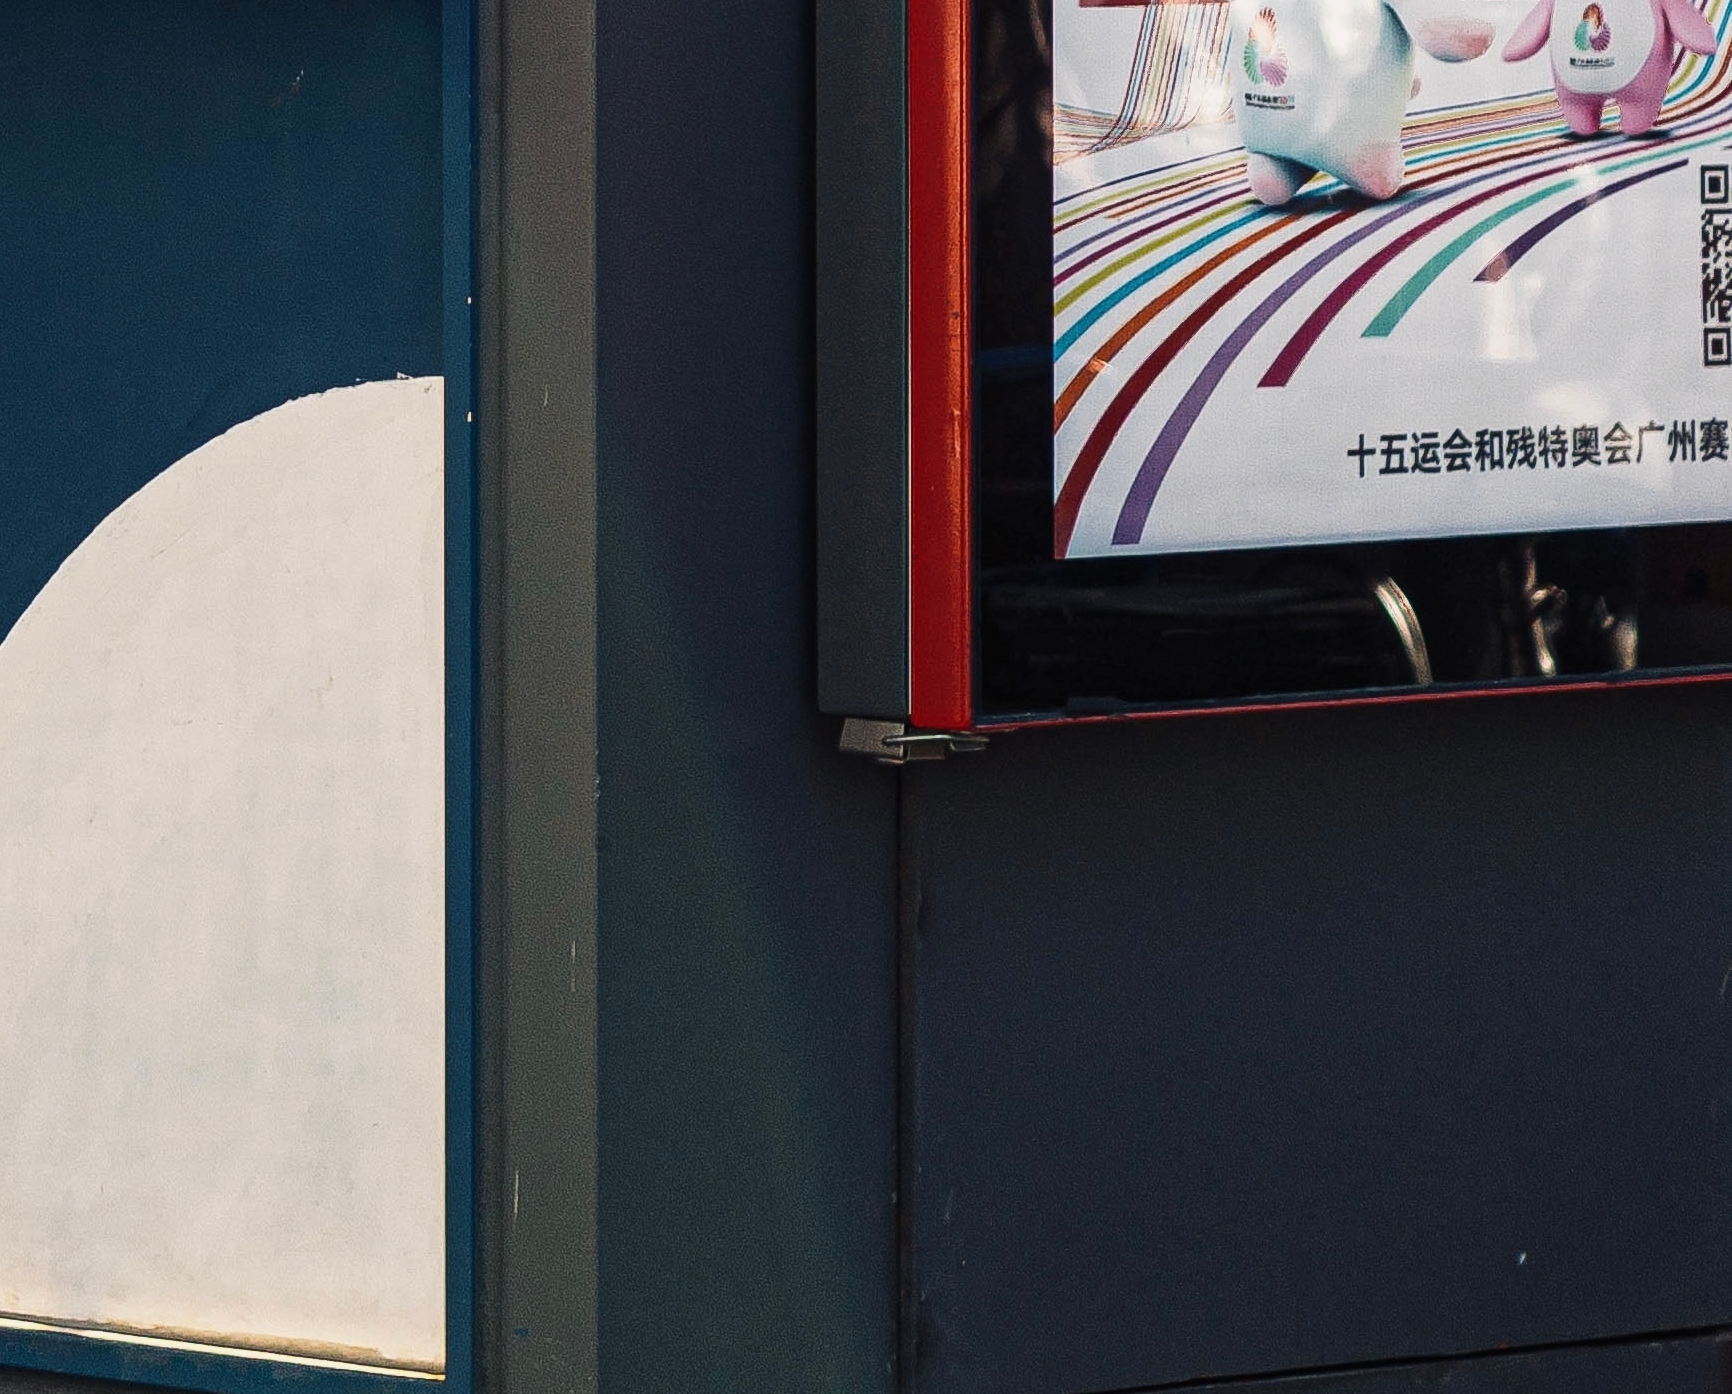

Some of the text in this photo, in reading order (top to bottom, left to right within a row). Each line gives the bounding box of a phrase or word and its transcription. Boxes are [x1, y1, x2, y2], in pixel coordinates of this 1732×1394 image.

[1346, 416, 1730, 479] 十五运会和残特奥会广州赛
